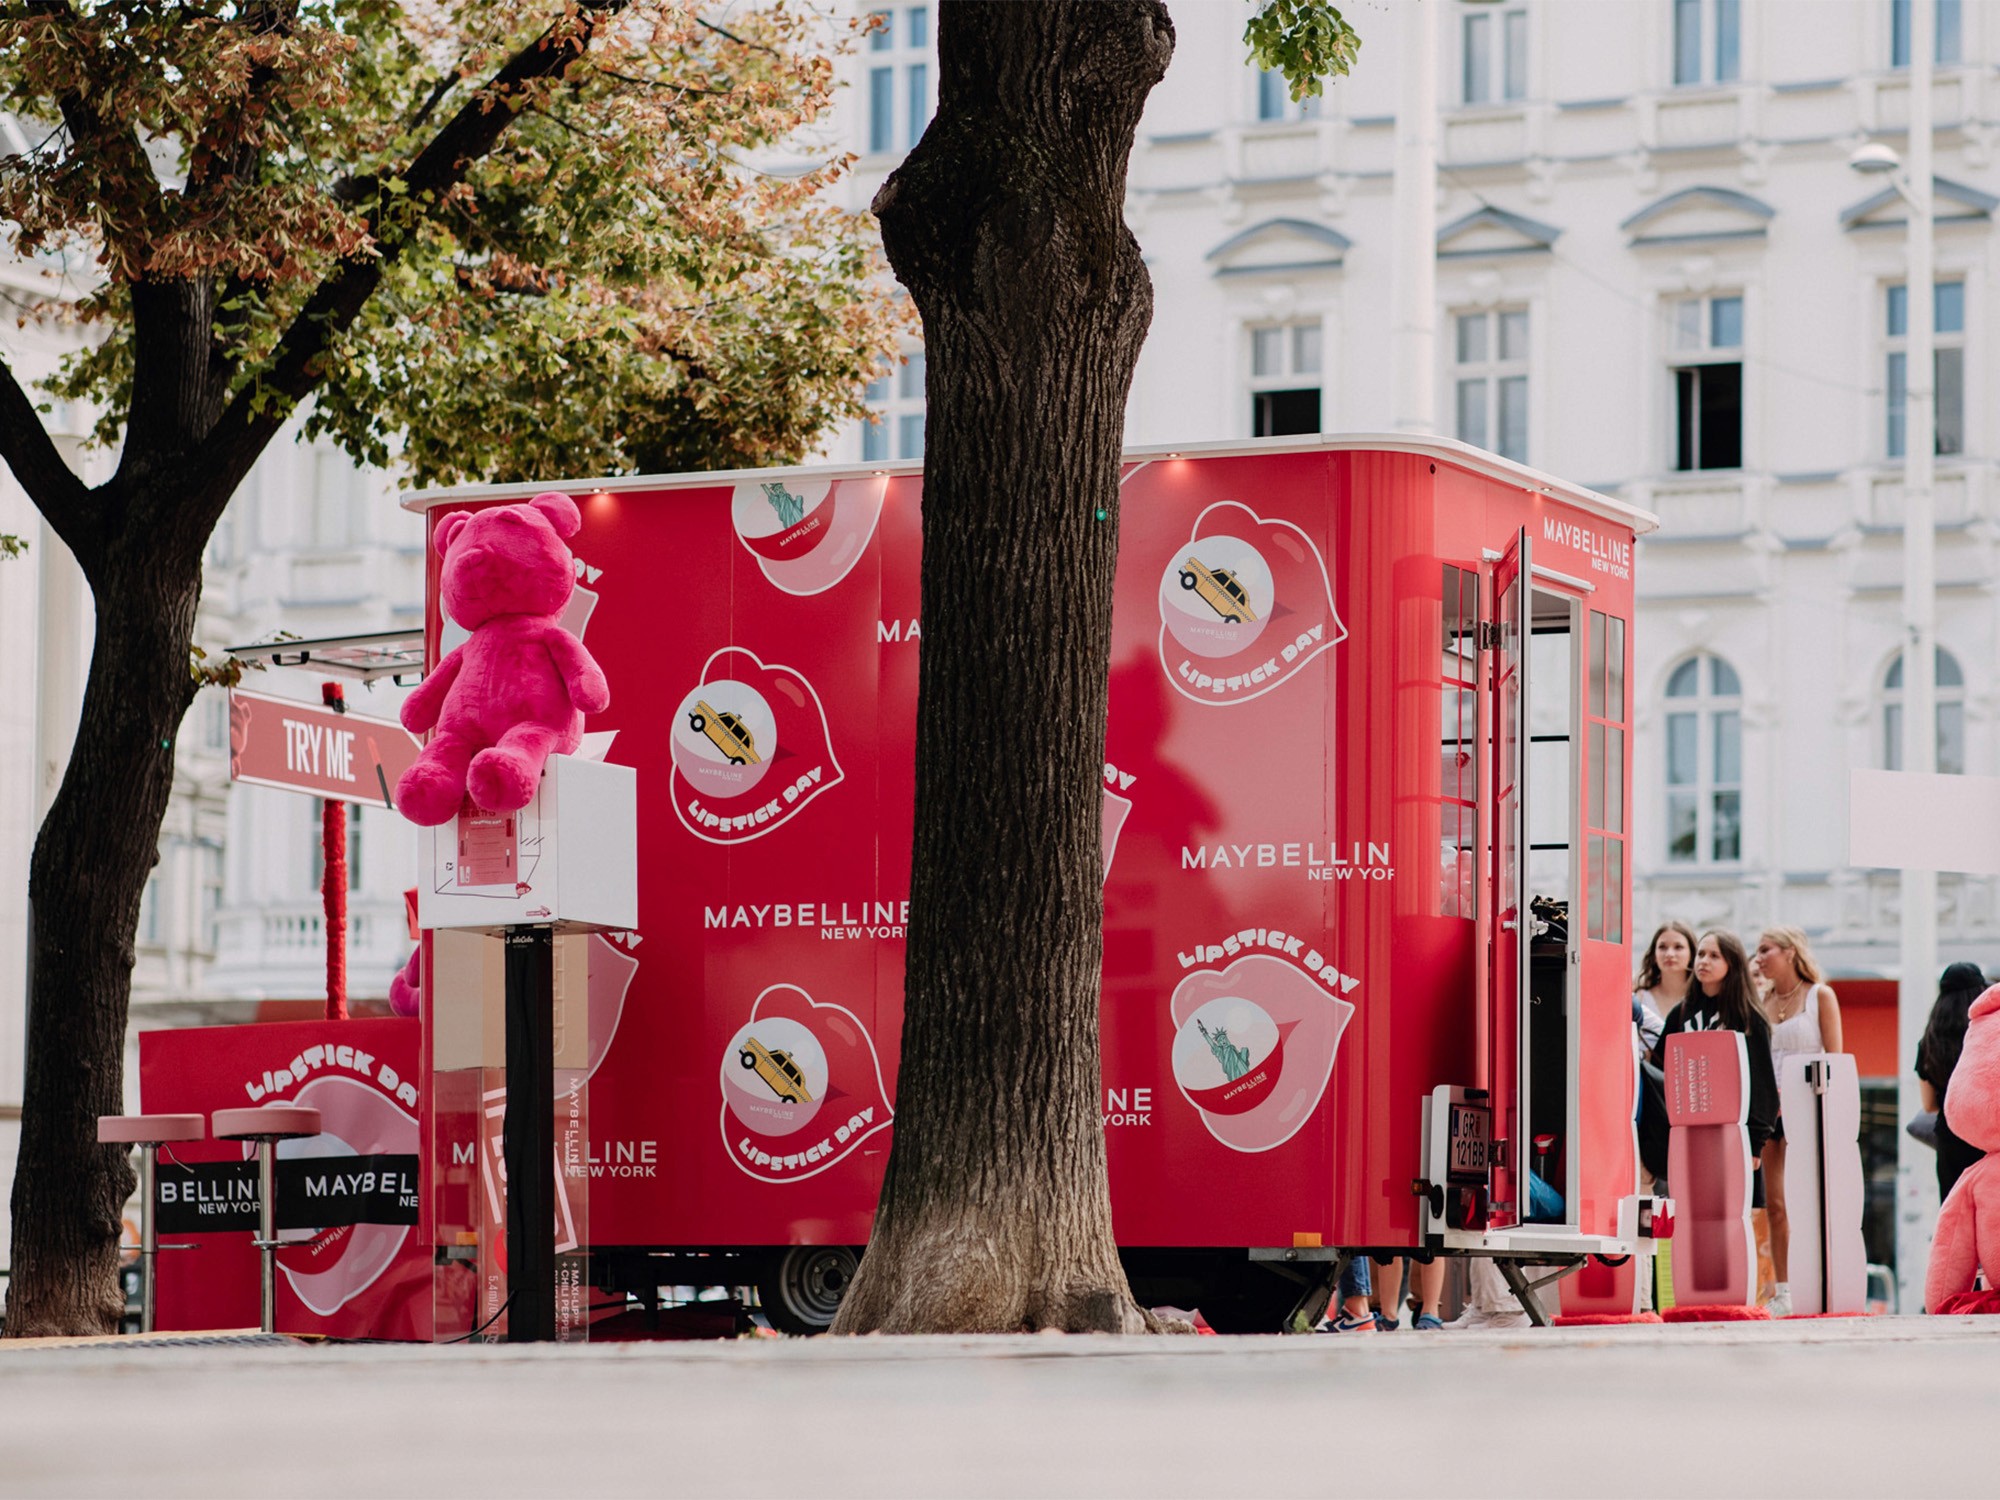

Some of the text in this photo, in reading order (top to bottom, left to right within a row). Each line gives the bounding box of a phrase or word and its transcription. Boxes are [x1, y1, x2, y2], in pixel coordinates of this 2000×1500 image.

[780, 517, 819, 546] MAYBELLINE
[1543, 516, 1630, 566] MAYBELLINE
[572, 557, 604, 584] AY
[1591, 557, 1630, 580] NEW YORK
[1178, 624, 1324, 694] LIPSTICK DAY
[282, 718, 356, 783] TRY ME
[1103, 763, 1137, 791] AY
[687, 766, 823, 832] LIPSTICK DAY
[1181, 842, 1389, 869] MAYBELLIN
[1307, 867, 1395, 881] NEW YOR
[821, 926, 908, 940] NEW YOR
[1177, 928, 1361, 994] LIPSTICK DAY
[245, 1043, 420, 1108] LIPSTICK DA
[1223, 1071, 1267, 1100] MAYBELLINE
[570, 1078, 579, 1174] MAYBELLINE
[1101, 1113, 1152, 1126] YORK
[1463, 1113, 1475, 1138] GR
[738, 1107, 874, 1171] LIPSTICK DAY
[305, 1172, 414, 1198] MAYBEL
[608, 1165, 657, 1178] YORK
[160, 1179, 261, 1204] BELLIN
[399, 1195, 418, 1208] NE
[198, 1201, 261, 1215] NEW YOR
[561, 1269, 569, 1297] CHILI
